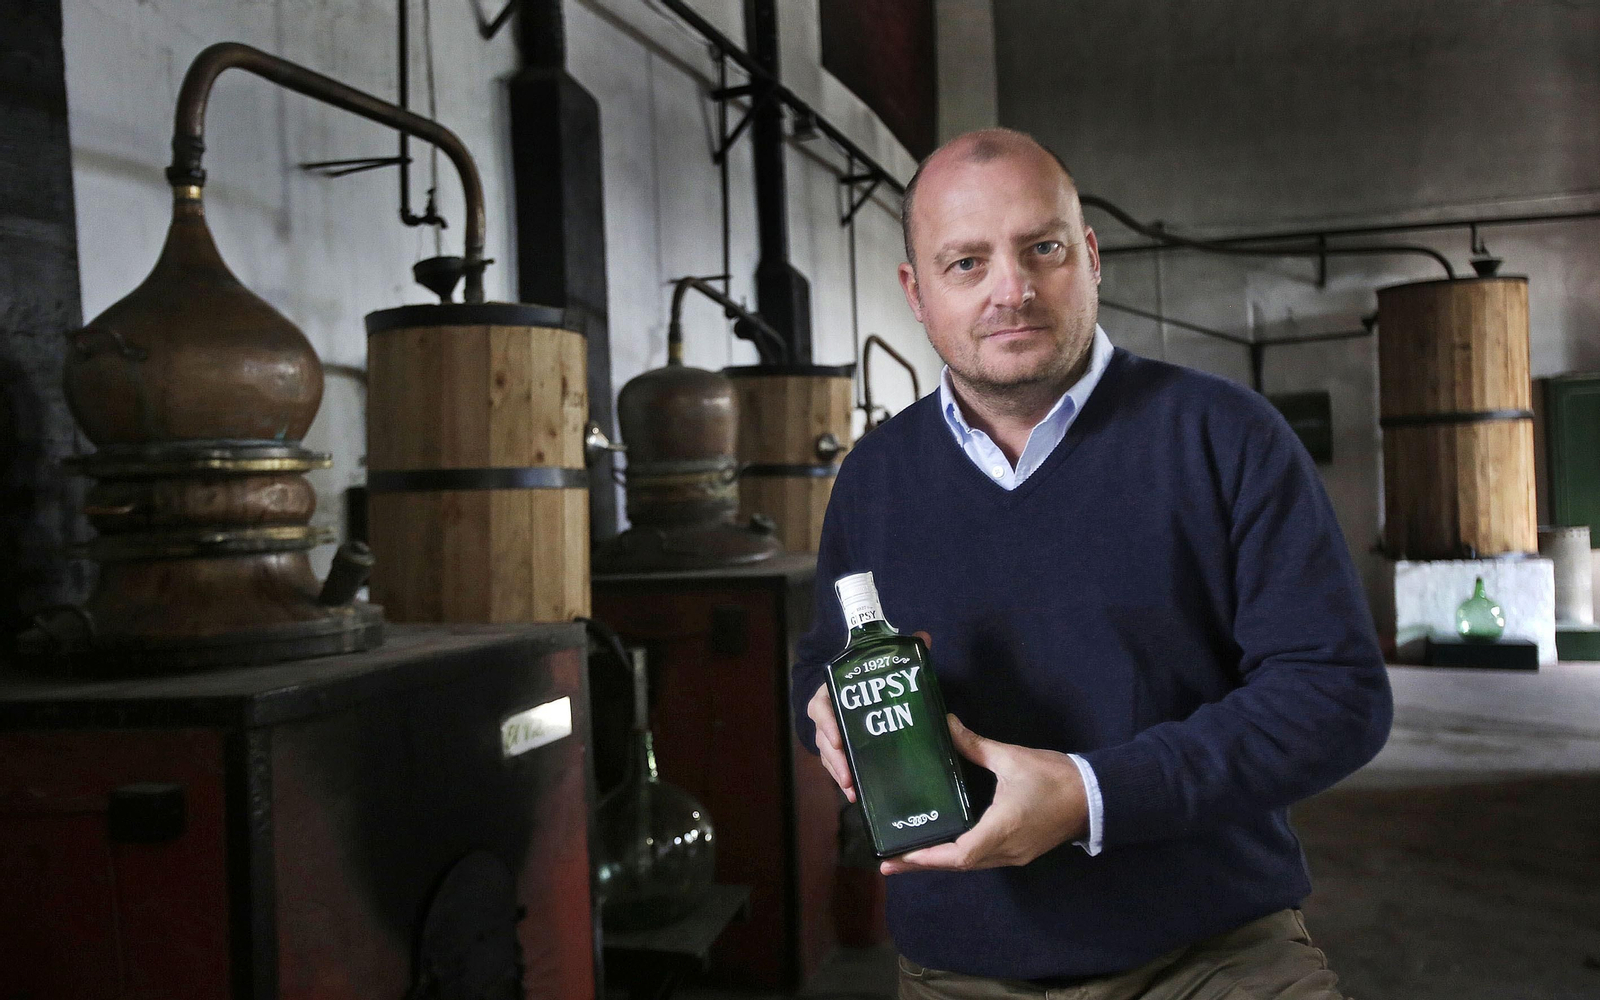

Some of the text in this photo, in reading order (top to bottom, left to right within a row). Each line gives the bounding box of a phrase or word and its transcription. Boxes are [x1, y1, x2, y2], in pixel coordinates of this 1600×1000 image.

[862, 656, 891, 673] 1927
[840, 666, 920, 710] GIPSY
[865, 702, 914, 736] GIN
